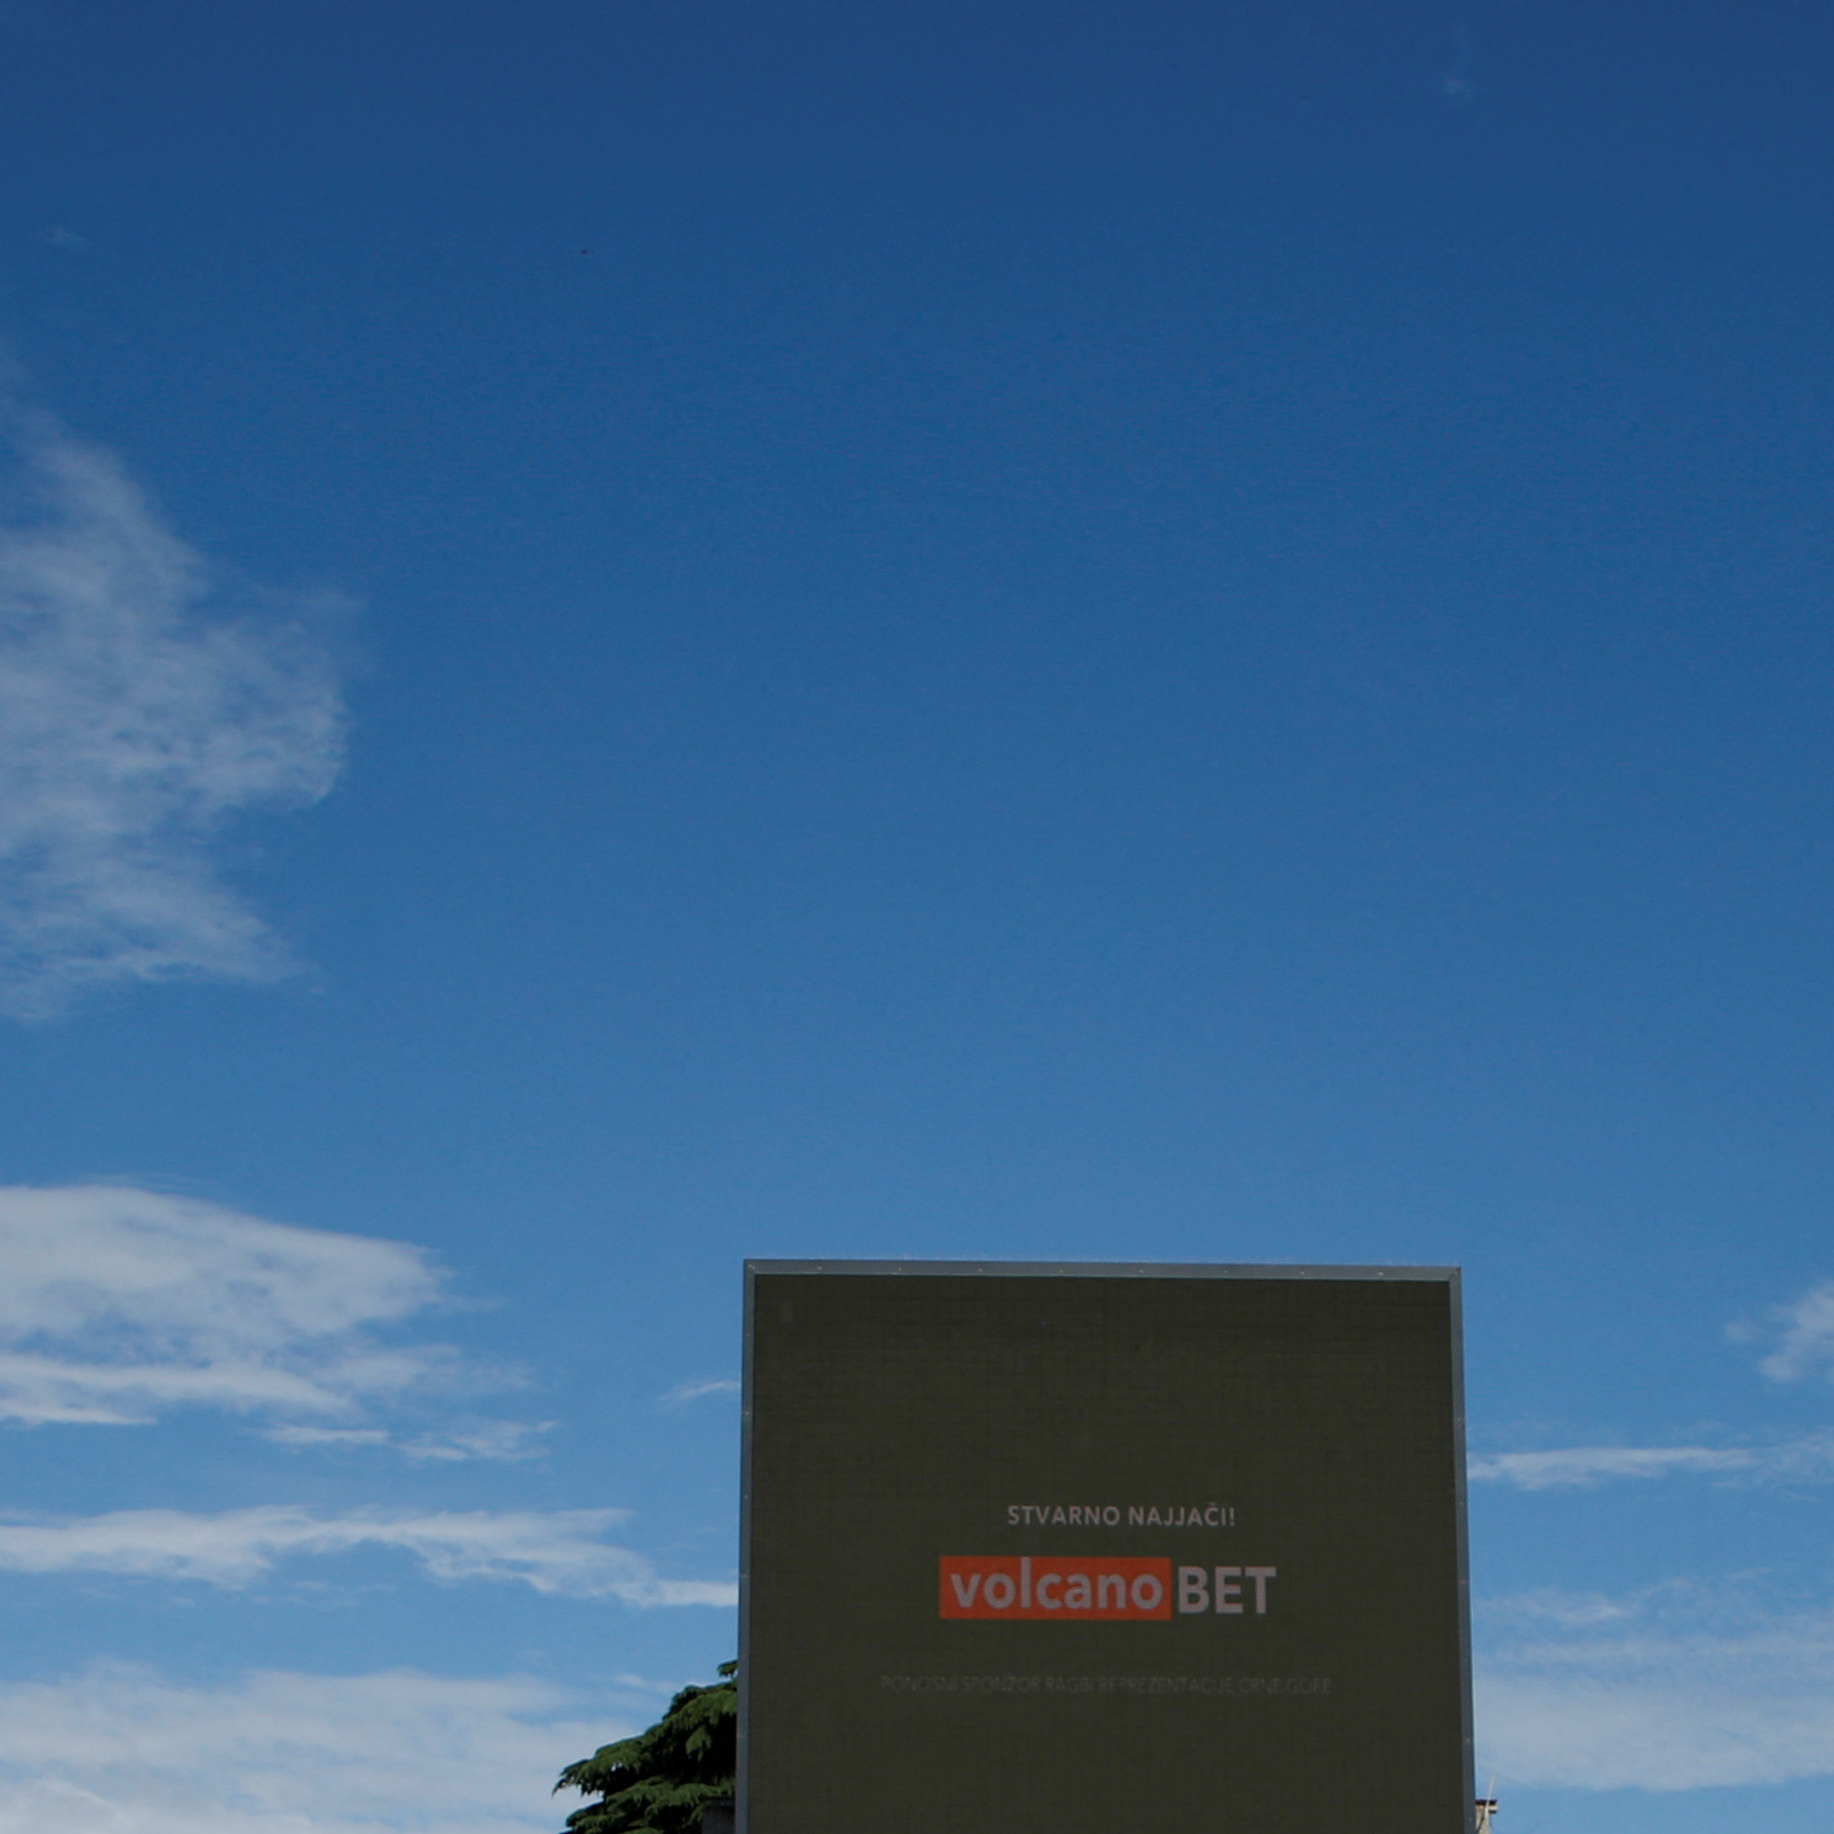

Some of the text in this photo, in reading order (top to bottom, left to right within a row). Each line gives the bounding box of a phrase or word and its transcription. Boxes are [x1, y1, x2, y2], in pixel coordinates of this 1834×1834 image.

[1008, 1502, 1236, 1527] STVARNO NAJJAČI!
[951, 1556, 1278, 1615] volcano BET
